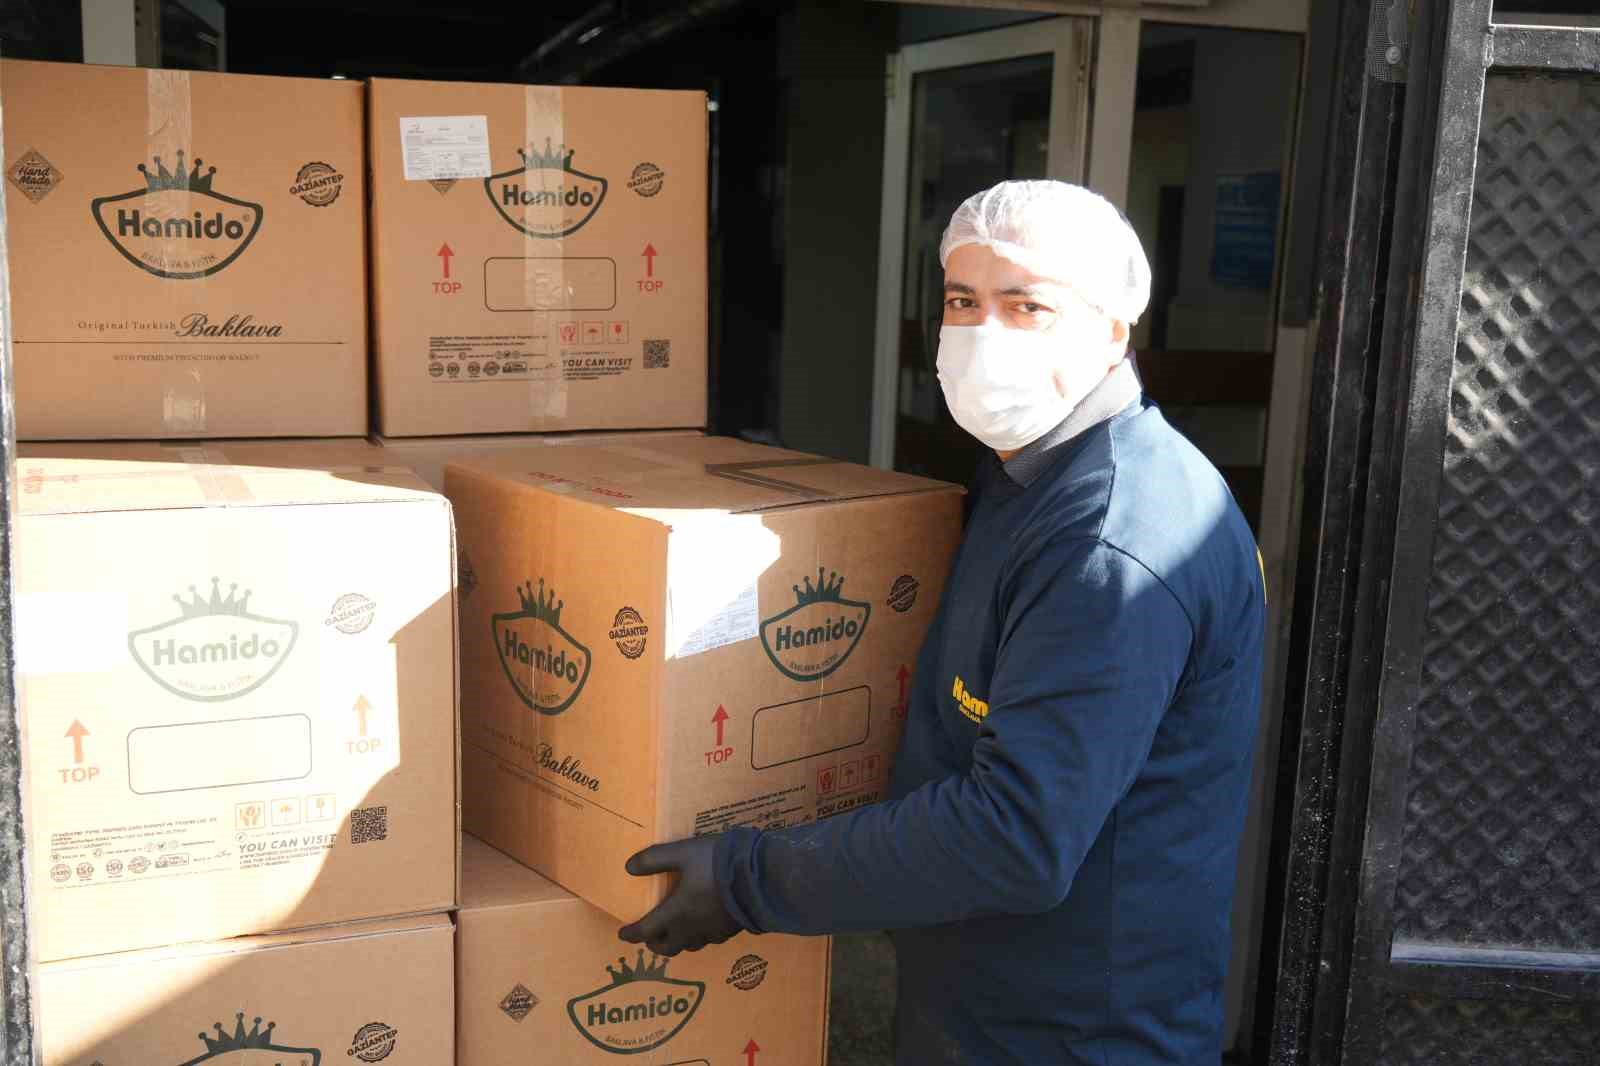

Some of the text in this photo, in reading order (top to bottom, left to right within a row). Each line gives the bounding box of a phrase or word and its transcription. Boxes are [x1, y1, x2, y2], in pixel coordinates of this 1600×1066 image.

[503, 184, 594, 207] Hamido
[118, 209, 244, 240] Hamido
[433, 281, 462, 294] TOP
[637, 280, 664, 292] TOP
[77, 312, 283, 339] Original Turkish Baklava
[562, 358, 632, 367] YOU CAN VISIT
[775, 616, 858, 652] Hamido
[153, 633, 279, 667] Hamido
[504, 628, 578, 682] Hamido
[345, 738, 381, 756] TOP
[705, 747, 734, 765] TOP
[58, 765, 99, 783] TOP
[536, 742, 600, 792] Baklava
[240, 842, 266, 853] YOU
[271, 838, 298, 849] CAN
[303, 833, 337, 846] VISIT
[588, 994, 688, 1026] Hamido
